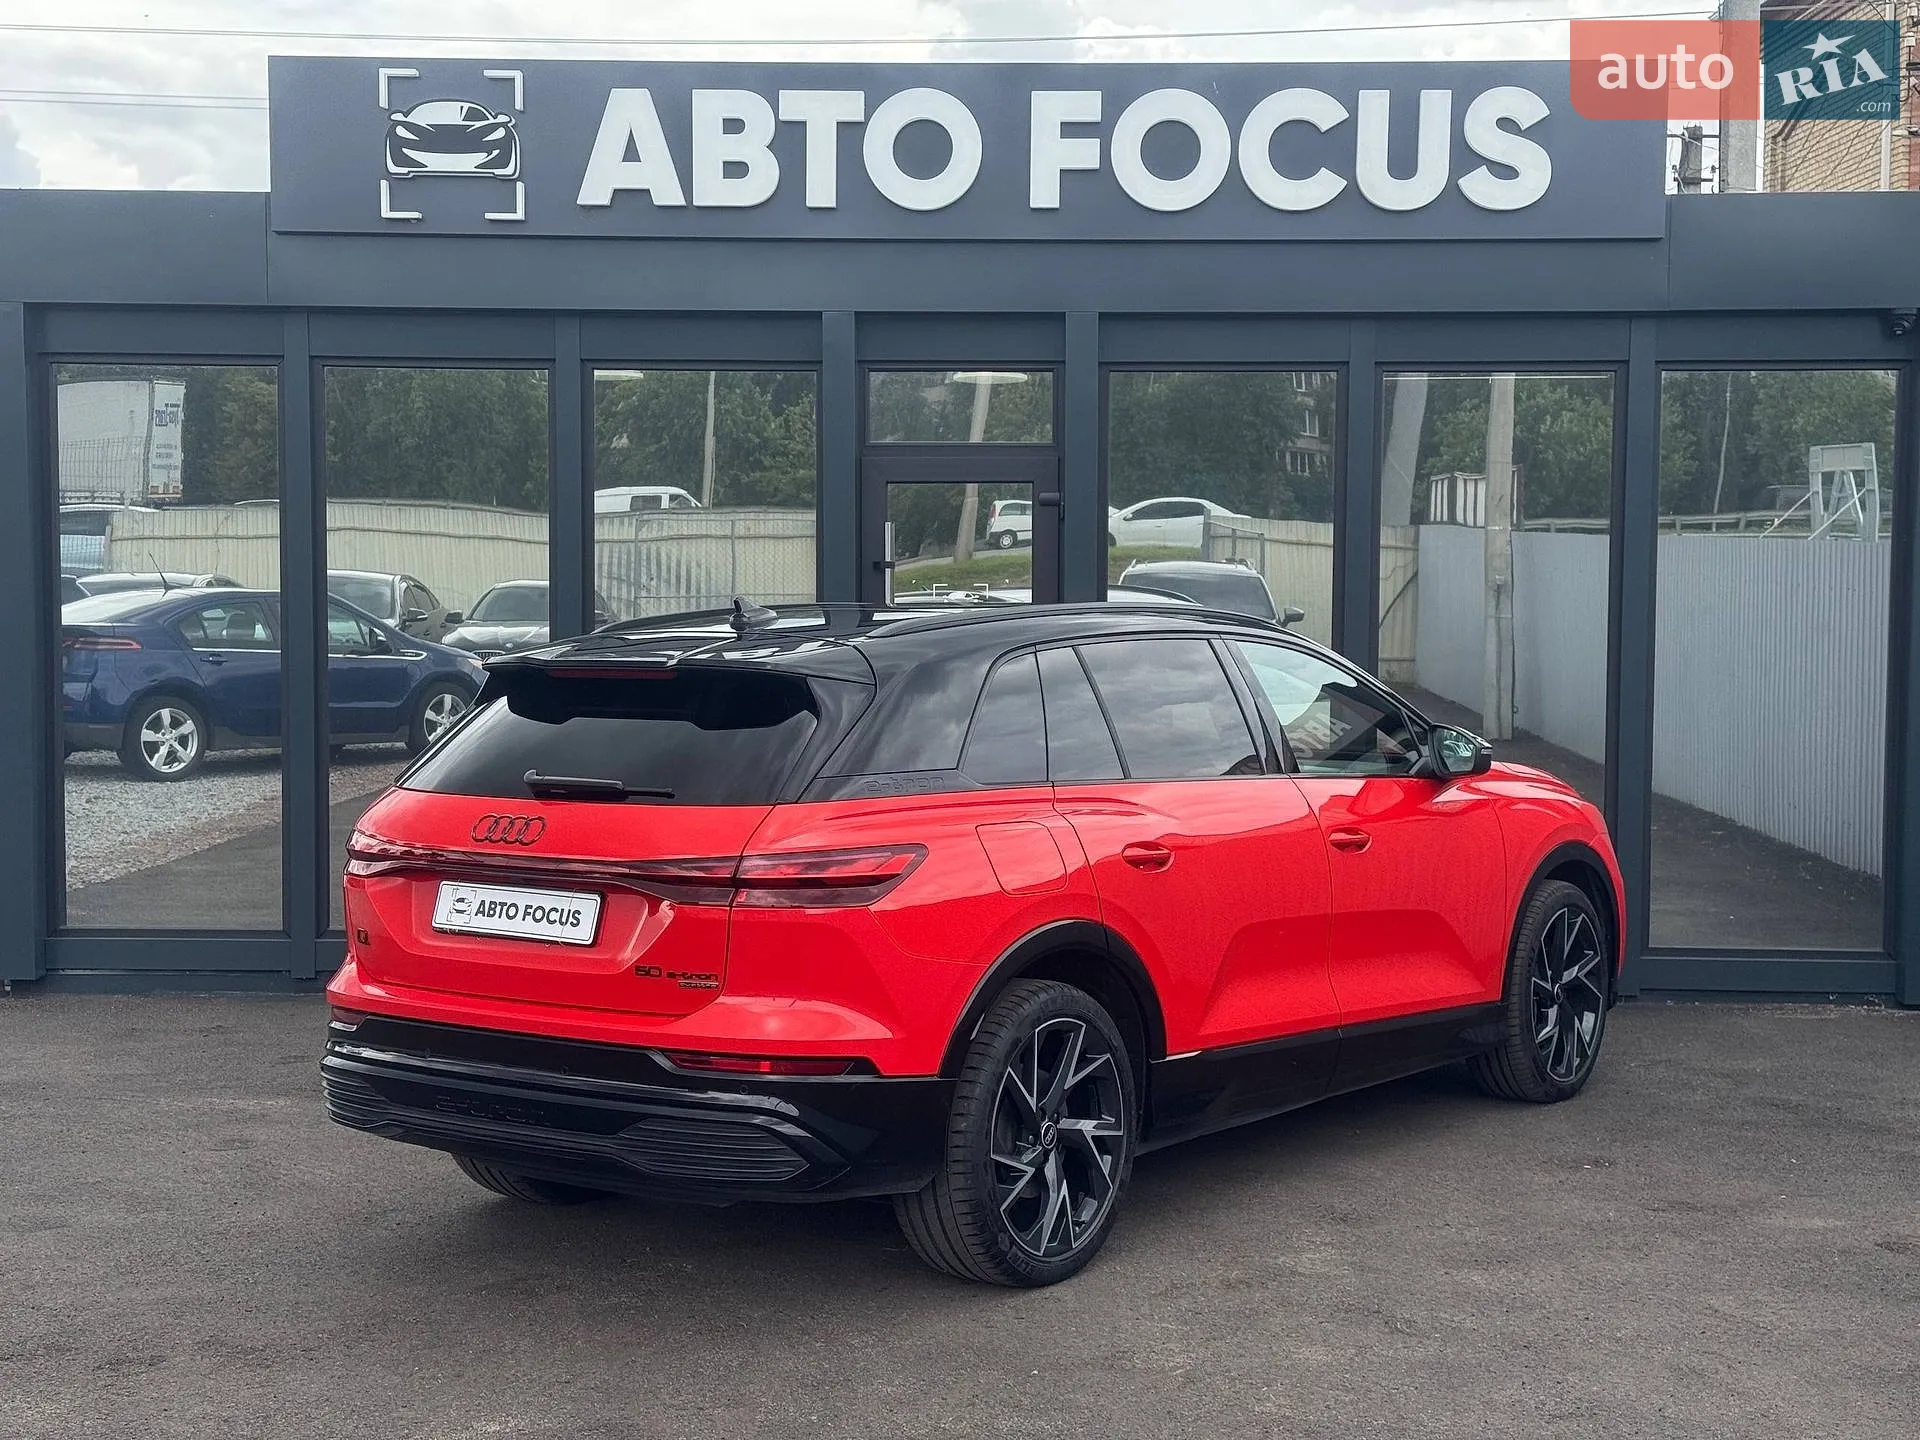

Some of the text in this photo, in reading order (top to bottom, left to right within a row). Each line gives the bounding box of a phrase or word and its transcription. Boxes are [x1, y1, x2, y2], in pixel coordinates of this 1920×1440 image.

[576, 86, 1554, 212] АВТО FOCUS
[475, 899, 583, 928] АВТО FOCUS
